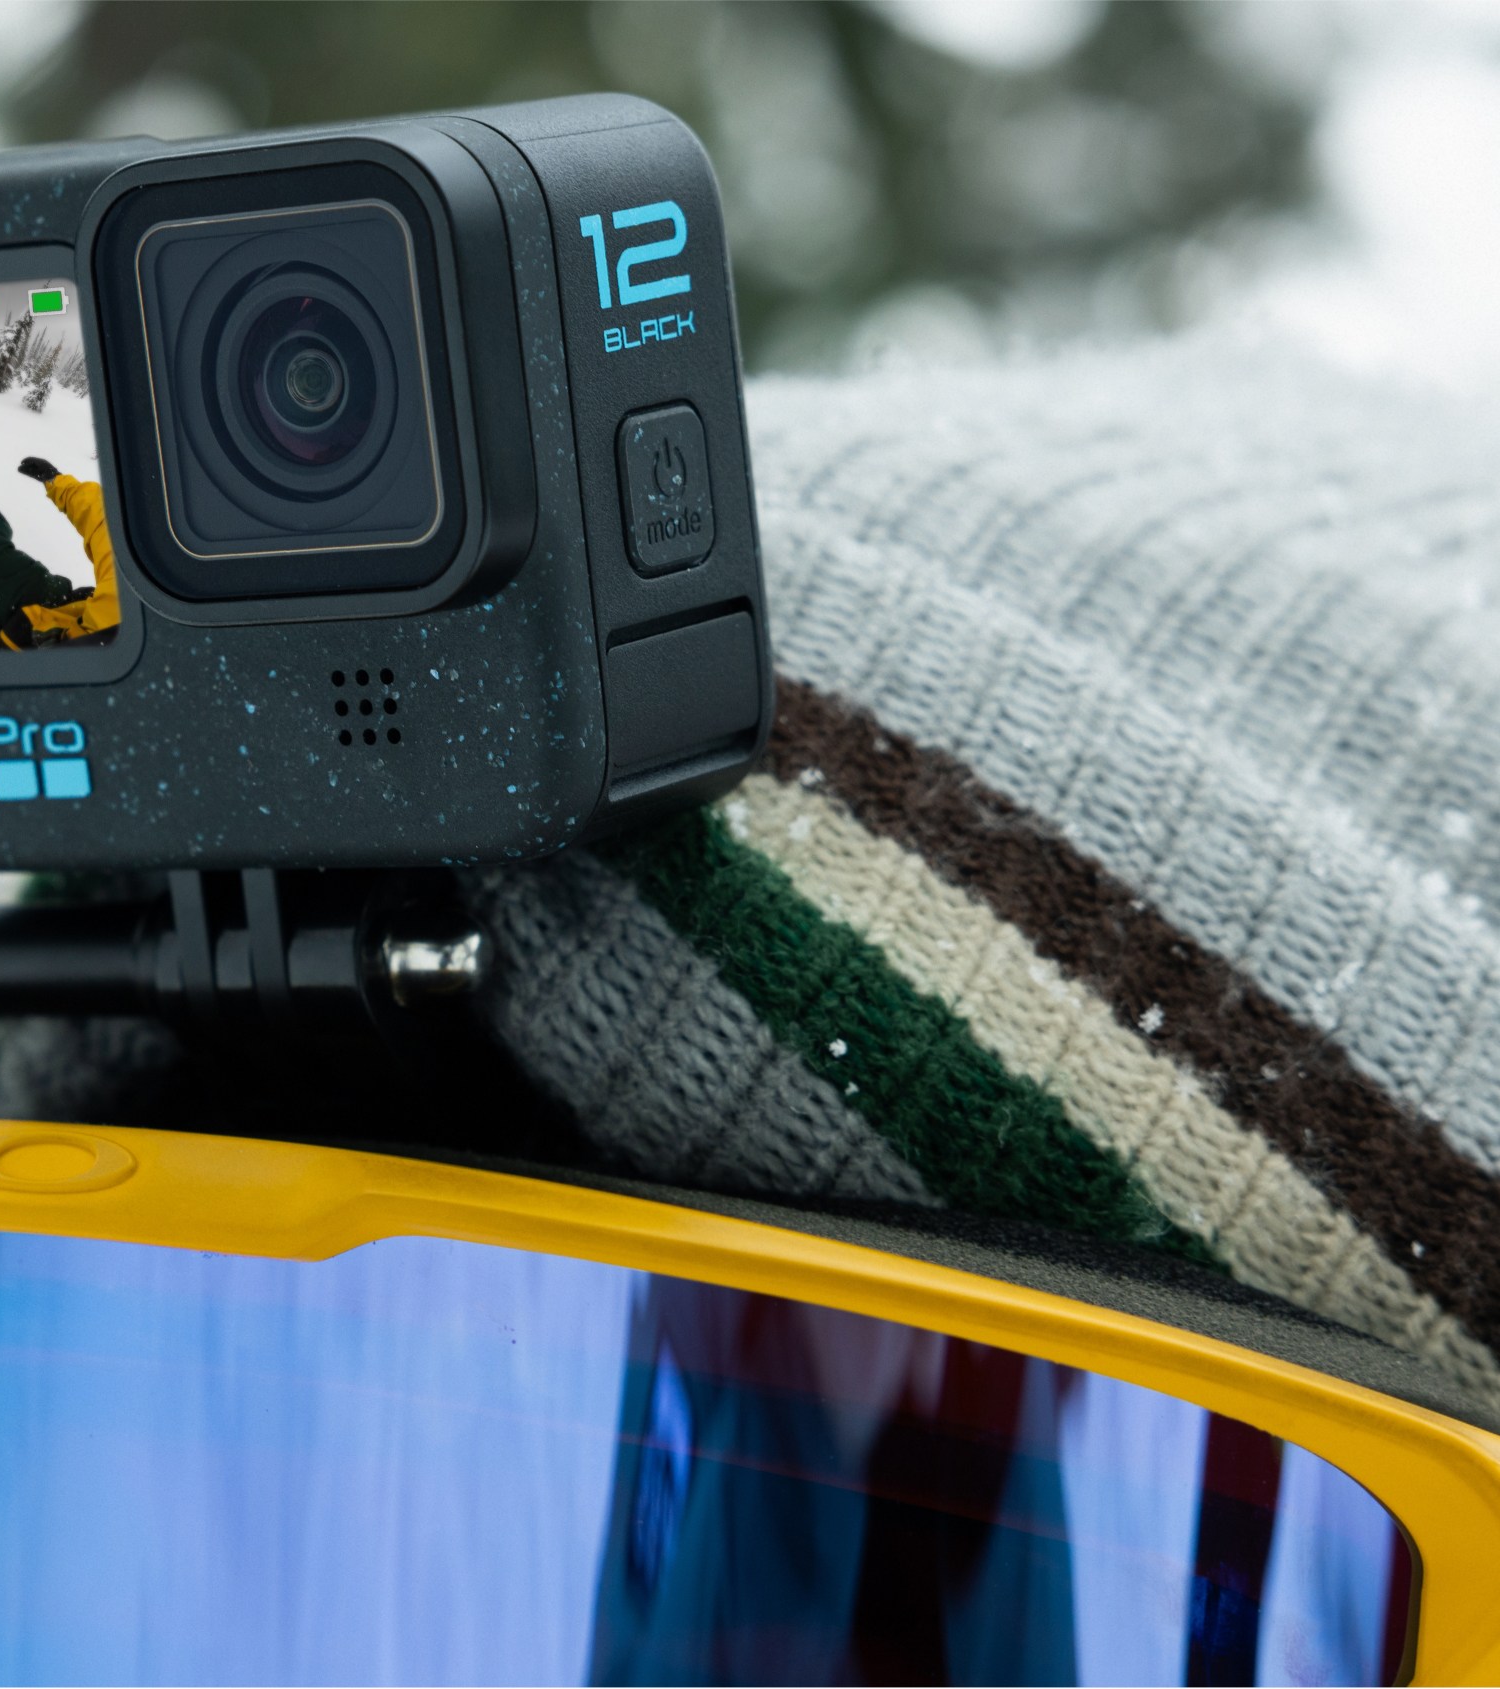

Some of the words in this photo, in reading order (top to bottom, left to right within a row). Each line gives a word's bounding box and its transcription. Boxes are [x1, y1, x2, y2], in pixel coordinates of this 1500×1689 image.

[580, 201, 691, 309] 12
[603, 310, 696, 352] BLACK
[647, 506, 701, 544] mode
